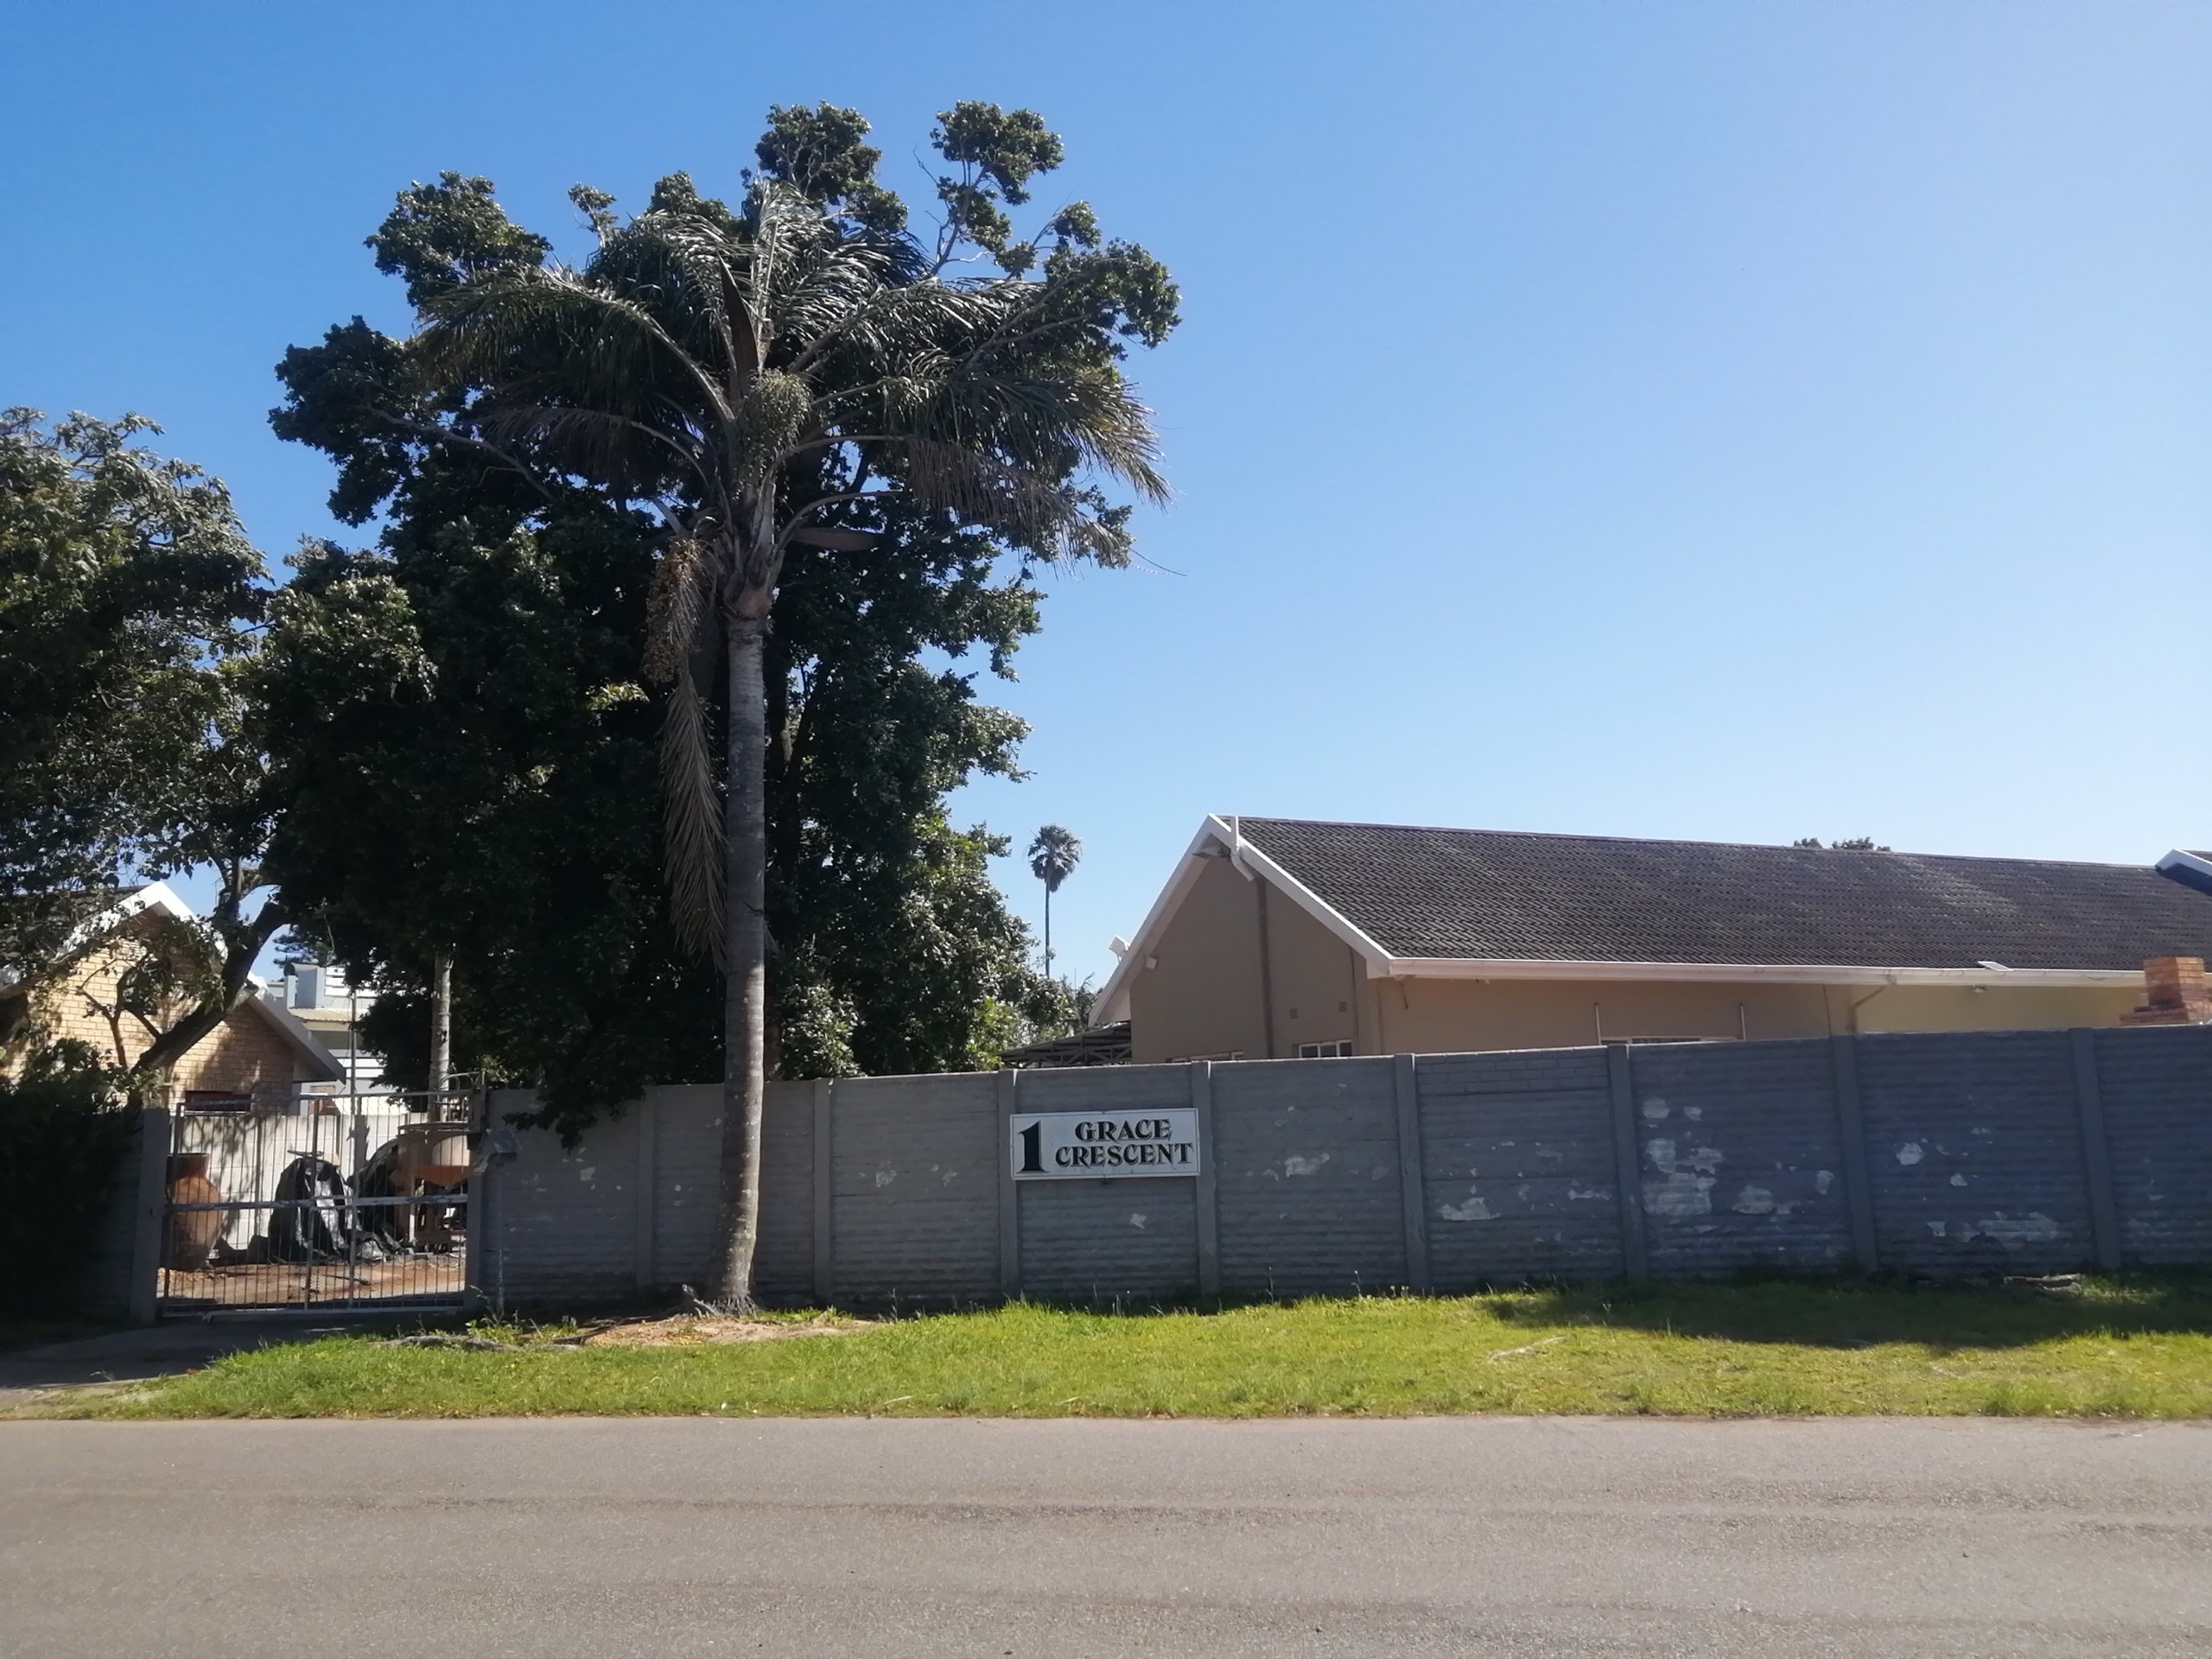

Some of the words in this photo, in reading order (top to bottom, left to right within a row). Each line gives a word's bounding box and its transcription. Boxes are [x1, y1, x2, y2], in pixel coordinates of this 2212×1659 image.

[1075, 1118, 1172, 1143] GRACE
[1017, 1121, 1049, 1173] 1
[1055, 1142, 1193, 1168] CRESCENT
